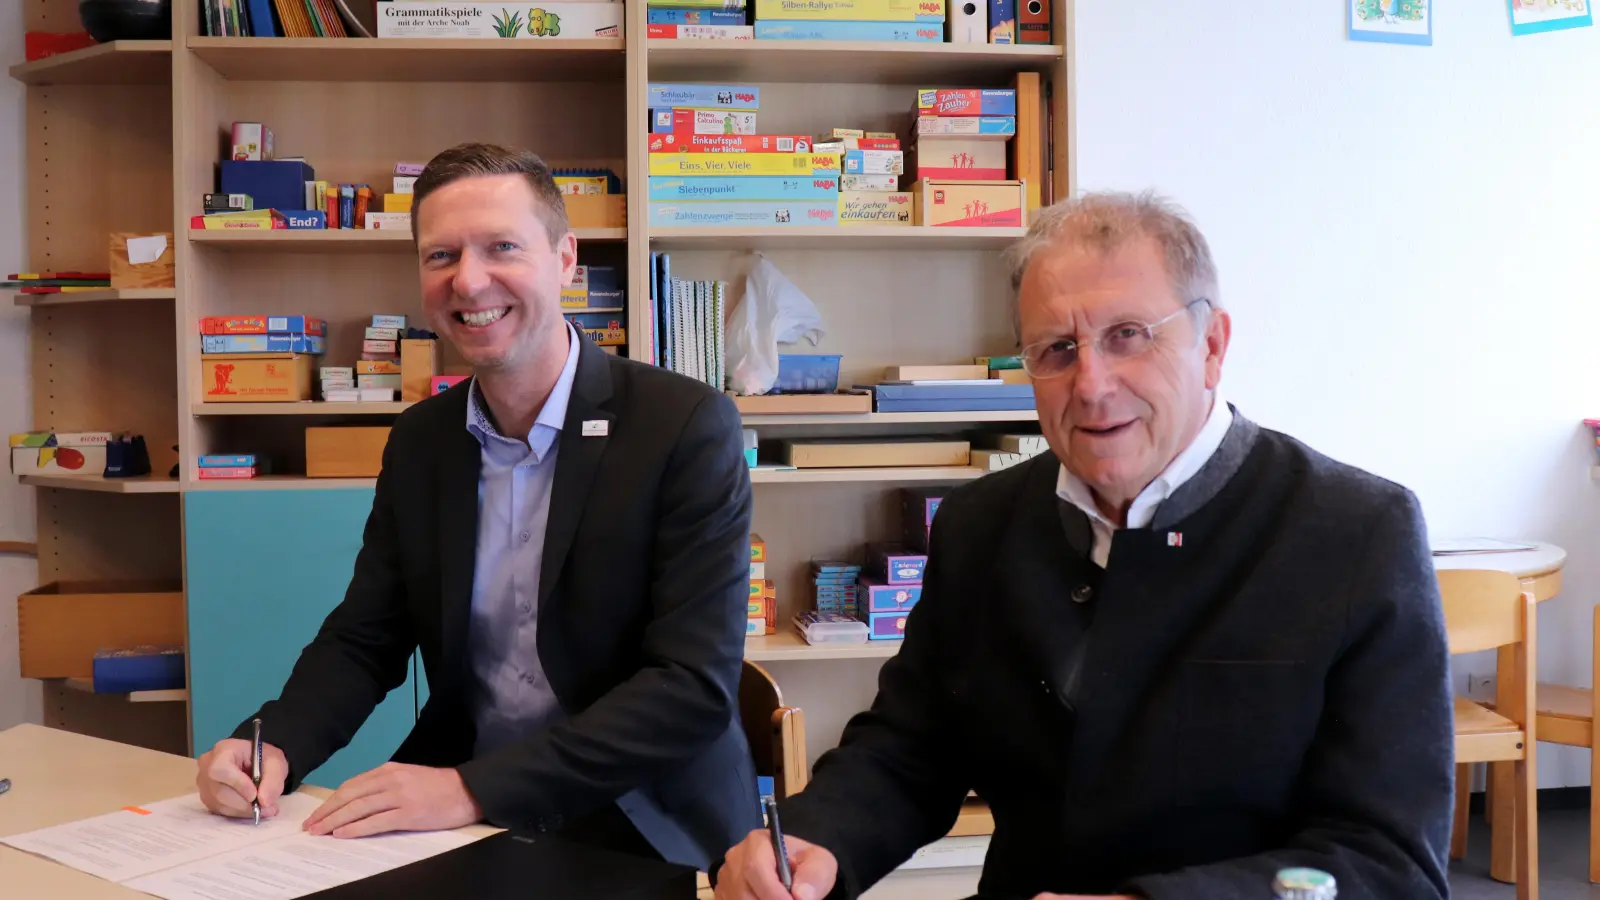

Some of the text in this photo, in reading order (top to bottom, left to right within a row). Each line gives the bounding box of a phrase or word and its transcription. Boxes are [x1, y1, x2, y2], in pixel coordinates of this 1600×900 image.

[781, 1, 834, 10] Silben-Rallye
[919, 3, 941, 12] HABA
[385, 7, 482, 18] Grammatikspiele
[916, 29, 939, 38] HABA
[735, 93, 755, 102] HABA
[940, 91, 966, 103] Zahlen
[937, 100, 972, 112] Zauber
[692, 136, 742, 144] Einkaufsspaß
[680, 161, 704, 170] Eins,
[728, 161, 751, 169] Viele
[812, 156, 834, 167] HABA
[813, 180, 835, 189] HABA
[678, 185, 736, 195] Siebenpunkt
[888, 195, 908, 204] HABA
[863, 202, 887, 211] gehen
[675, 212, 733, 221] Zahlenzwerge
[808, 209, 834, 220] HABA
[840, 209, 895, 219] einkaufen
[289, 217, 318, 227] End?
[586, 330, 604, 341] ode
